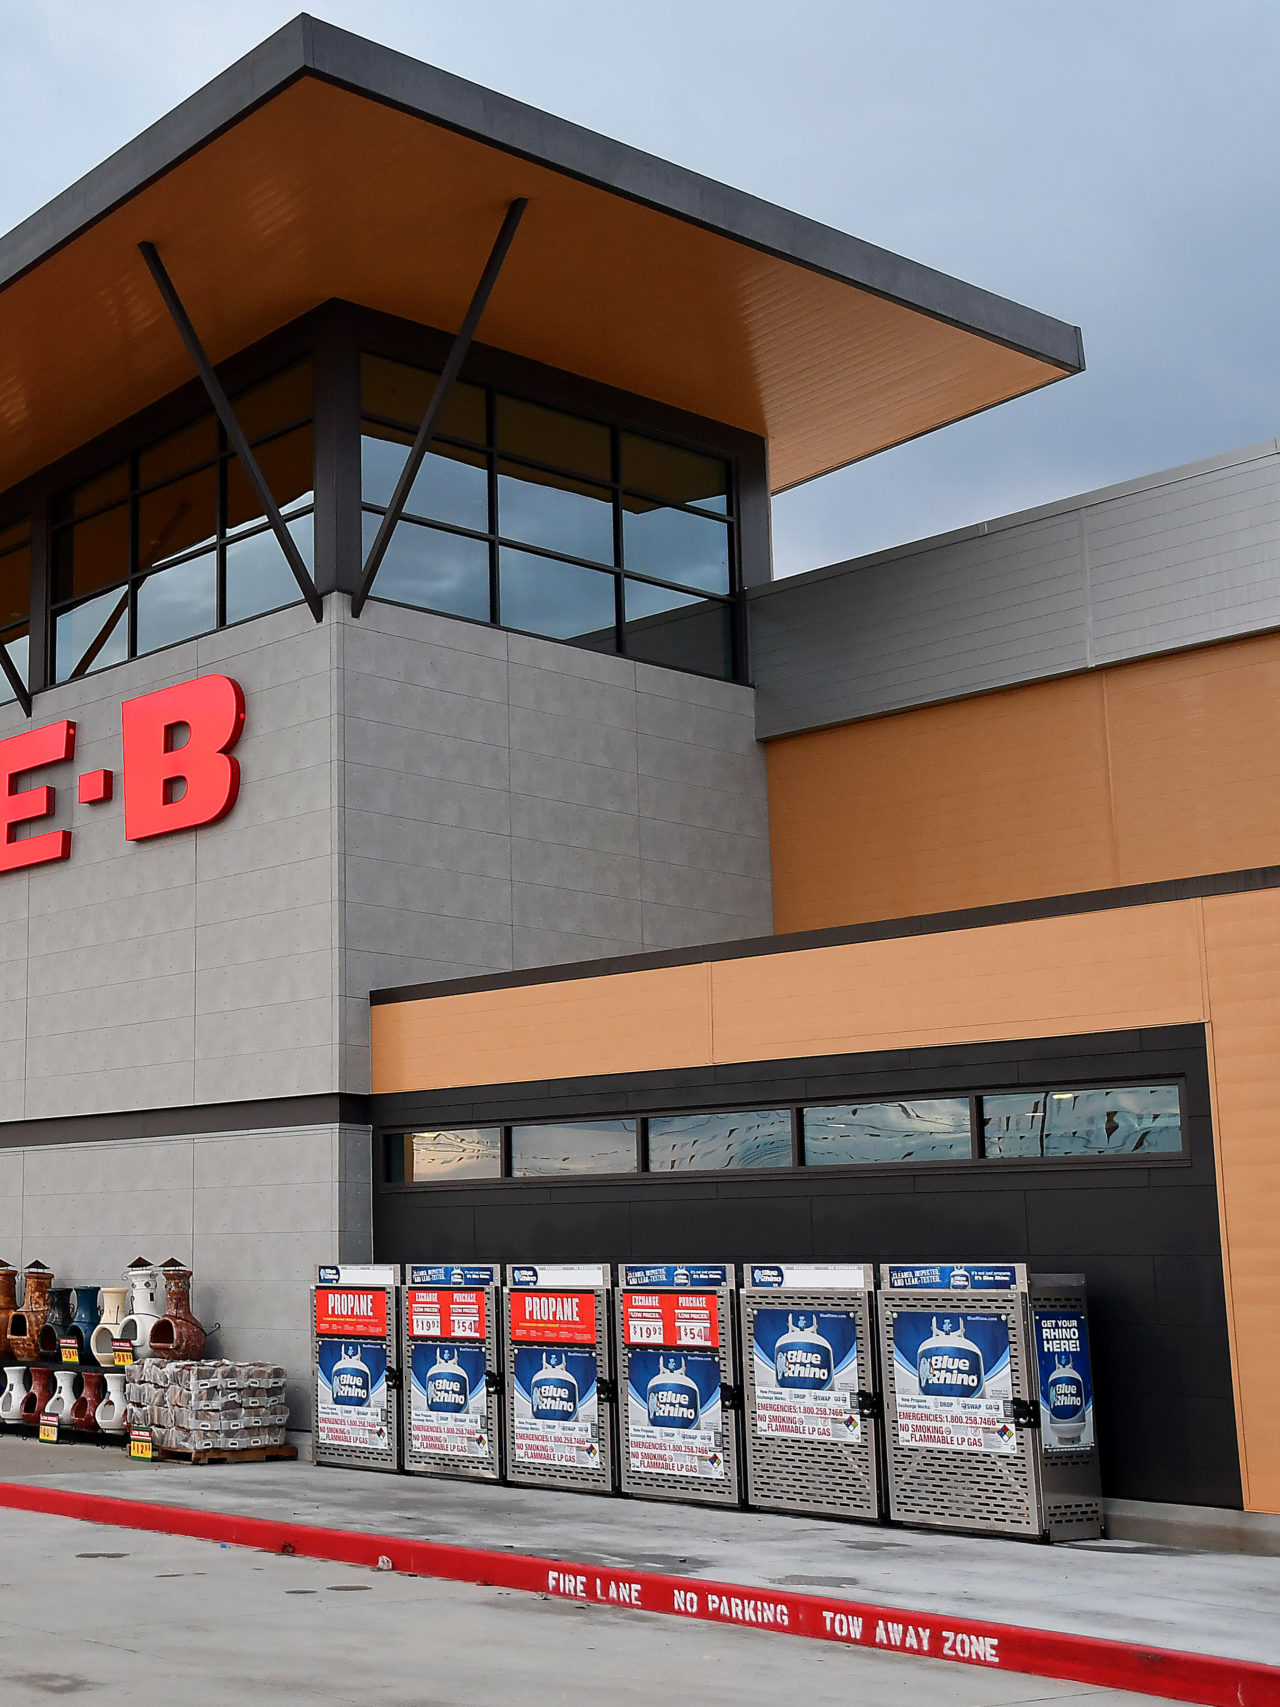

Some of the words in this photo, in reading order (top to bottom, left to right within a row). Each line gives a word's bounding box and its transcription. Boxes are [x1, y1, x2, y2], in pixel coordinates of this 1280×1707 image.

[328, 1294, 373, 1316] PROPANE
[632, 1296, 659, 1306] EXCHANGE
[678, 1296, 706, 1307] PURCHASE
[525, 1297, 579, 1321] PROPANE
[457, 1320, 473, 1332] $54
[684, 1326, 703, 1340] $54
[1042, 1328, 1079, 1339] RHINO
[1044, 1340, 1080, 1352] HERE!
[787, 1350, 821, 1364] Blue
[931, 1356, 969, 1370] Blue
[784, 1364, 828, 1380] Rhino
[928, 1369, 978, 1387] Rhino
[340, 1374, 362, 1385] Blue
[435, 1379, 460, 1391] Blue
[338, 1385, 367, 1398] Rhino
[541, 1385, 569, 1398] Blue
[1056, 1384, 1077, 1394] Blue
[433, 1390, 464, 1405] Rhino
[658, 1391, 689, 1404] Blue
[1055, 1395, 1080, 1406] Rhino
[539, 1398, 574, 1412] Rhino
[656, 1404, 695, 1419] Rhino
[768, 1415, 796, 1425] SMOKING
[767, 1423, 806, 1434] FLAMMABLE
[808, 1427, 816, 1435] LP
[817, 1428, 831, 1436] GAS
[900, 1424, 909, 1432] NO
[911, 1424, 944, 1435] SMOKING
[420, 1442, 449, 1451] FLAMMABLE
[911, 1434, 955, 1445] FLAMMABLE
[957, 1437, 965, 1446] LP
[967, 1438, 982, 1447] GAS
[525, 1443, 548, 1452] SMOKING
[524, 1452, 556, 1461] FLAMMABLE
[557, 1454, 564, 1462] LP
[565, 1455, 575, 1463] GAS
[641, 1453, 667, 1461] SMOKING
[640, 1460, 675, 1471] FLAMMABLE
[677, 1463, 684, 1472] LP
[685, 1464, 697, 1473] GAS
[548, 1570, 587, 1598] FIRE
[596, 1577, 642, 1606] LANE
[673, 1589, 698, 1613] NO
[708, 1593, 789, 1627] PARKING
[822, 1611, 863, 1640] TOW
[875, 1619, 930, 1651] AWAY
[941, 1631, 1000, 1663] ZONE
